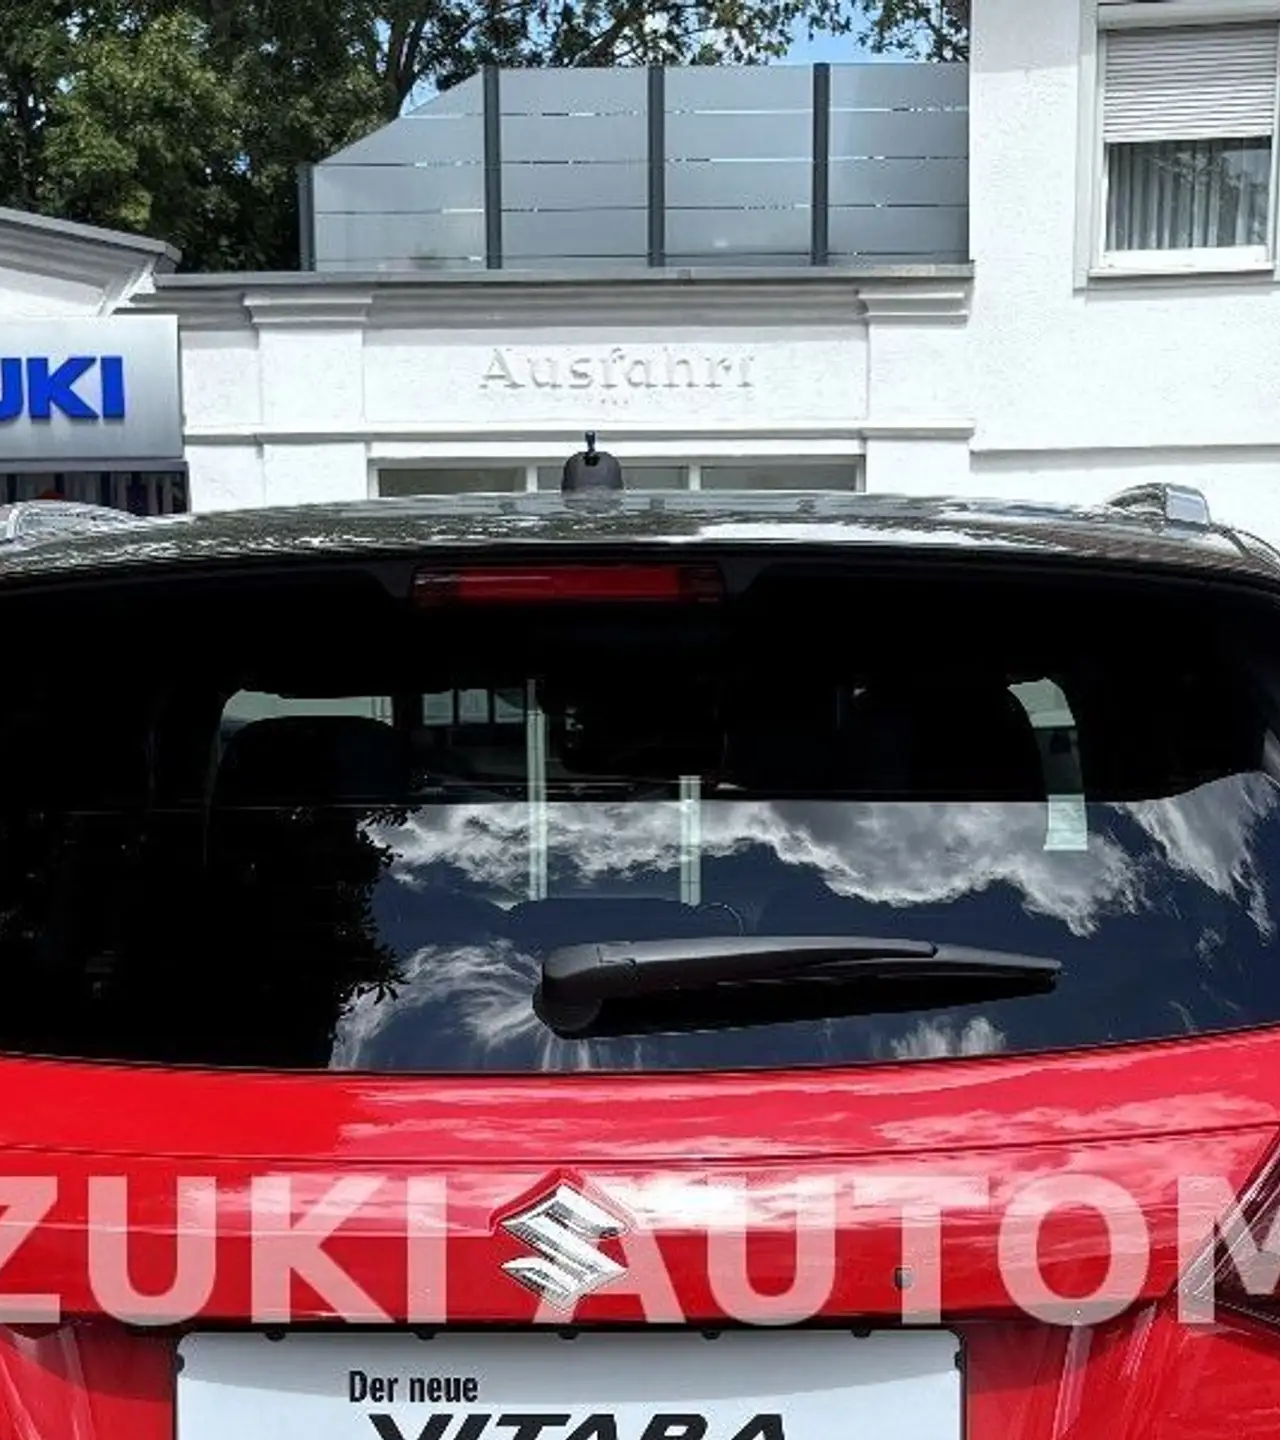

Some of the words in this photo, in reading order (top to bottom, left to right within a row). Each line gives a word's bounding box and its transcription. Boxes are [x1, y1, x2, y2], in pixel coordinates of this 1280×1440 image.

[479, 347, 755, 389] Ausfahrt
[349, 1370, 399, 1403] Der
[409, 1376, 478, 1403] neue
